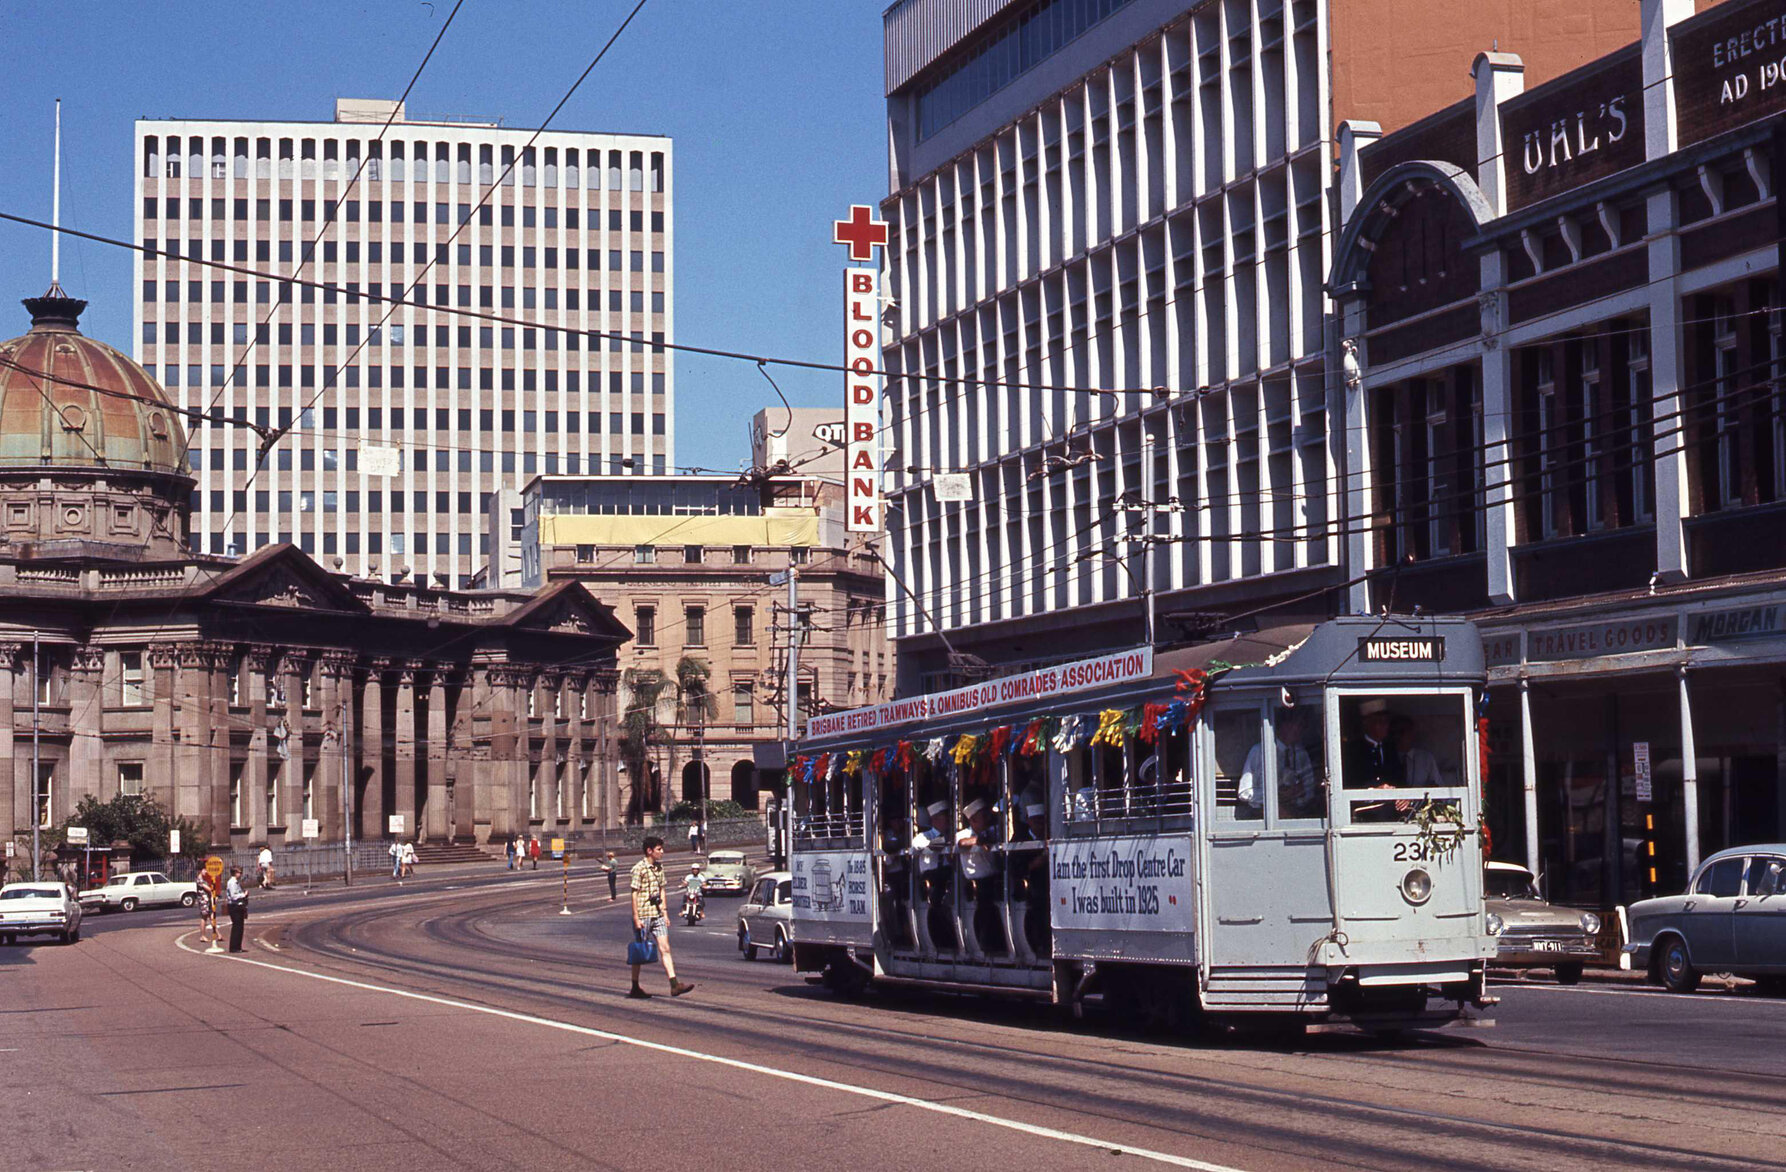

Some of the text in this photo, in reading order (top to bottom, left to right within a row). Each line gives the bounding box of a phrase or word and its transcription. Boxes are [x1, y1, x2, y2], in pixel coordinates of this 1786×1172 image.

[1721, 73, 1748, 104] AD
[1524, 95, 1627, 175] UHL'S
[852, 274, 874, 525] BLOOD BANK
[1535, 623, 1668, 655] TRAVEL GOODS
[1692, 606, 1778, 643] MORGAN
[1367, 642, 1432, 659] MUSEUM
[811, 653, 1144, 736] BRISBANE RETIRED TRAMWAYS & OMNIBUS OLD COMRADES ASSOCIATION
[1057, 861, 1071, 880] am
[1072, 854, 1087, 880] the
[1090, 851, 1110, 879] first
[1112, 850, 1135, 887] Drop
[1137, 849, 1166, 878] Centre
[1167, 848, 1185, 877] Car
[849, 899, 866, 914] TRAM
[1077, 897, 1099, 914] was
[1100, 885, 1123, 914] built
[1125, 888, 1136, 914] in
[1137, 885, 1159, 914] 1925
